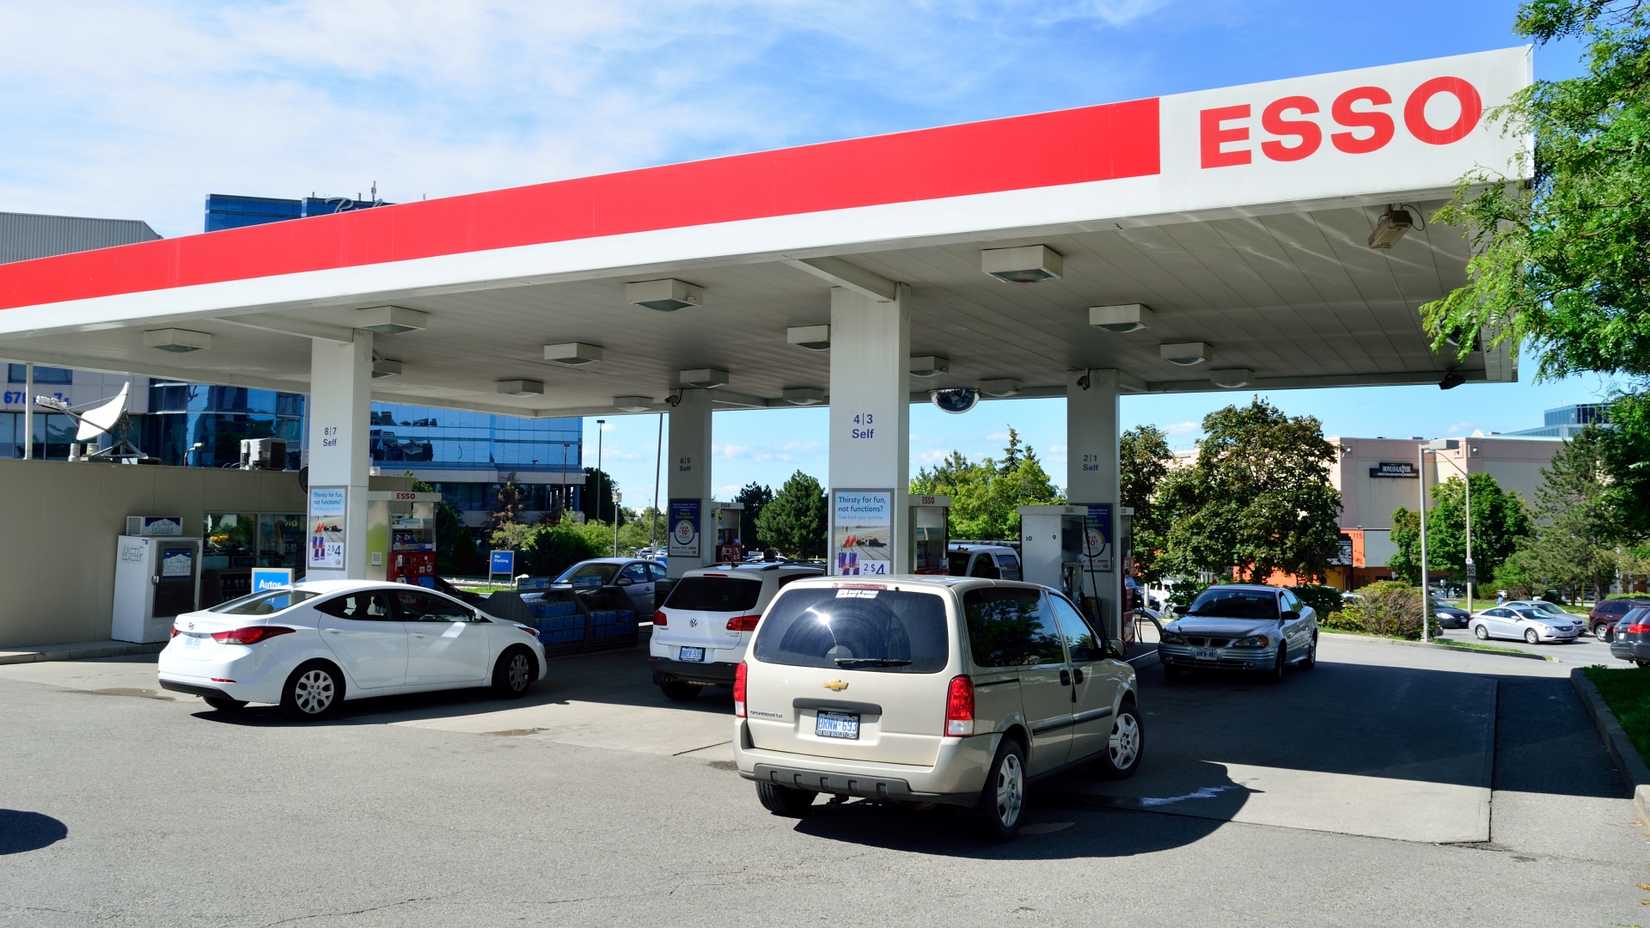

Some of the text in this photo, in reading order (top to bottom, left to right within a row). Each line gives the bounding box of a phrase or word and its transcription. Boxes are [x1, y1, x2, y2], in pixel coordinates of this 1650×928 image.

[1199, 75, 1483, 170] ESSO
[852, 428, 874, 439] Self
[322, 438, 337, 447] Self
[396, 492, 416, 500] ESSO
[838, 495, 887, 504] Thirsty for fun,
[850, 505, 884, 513] functions?
